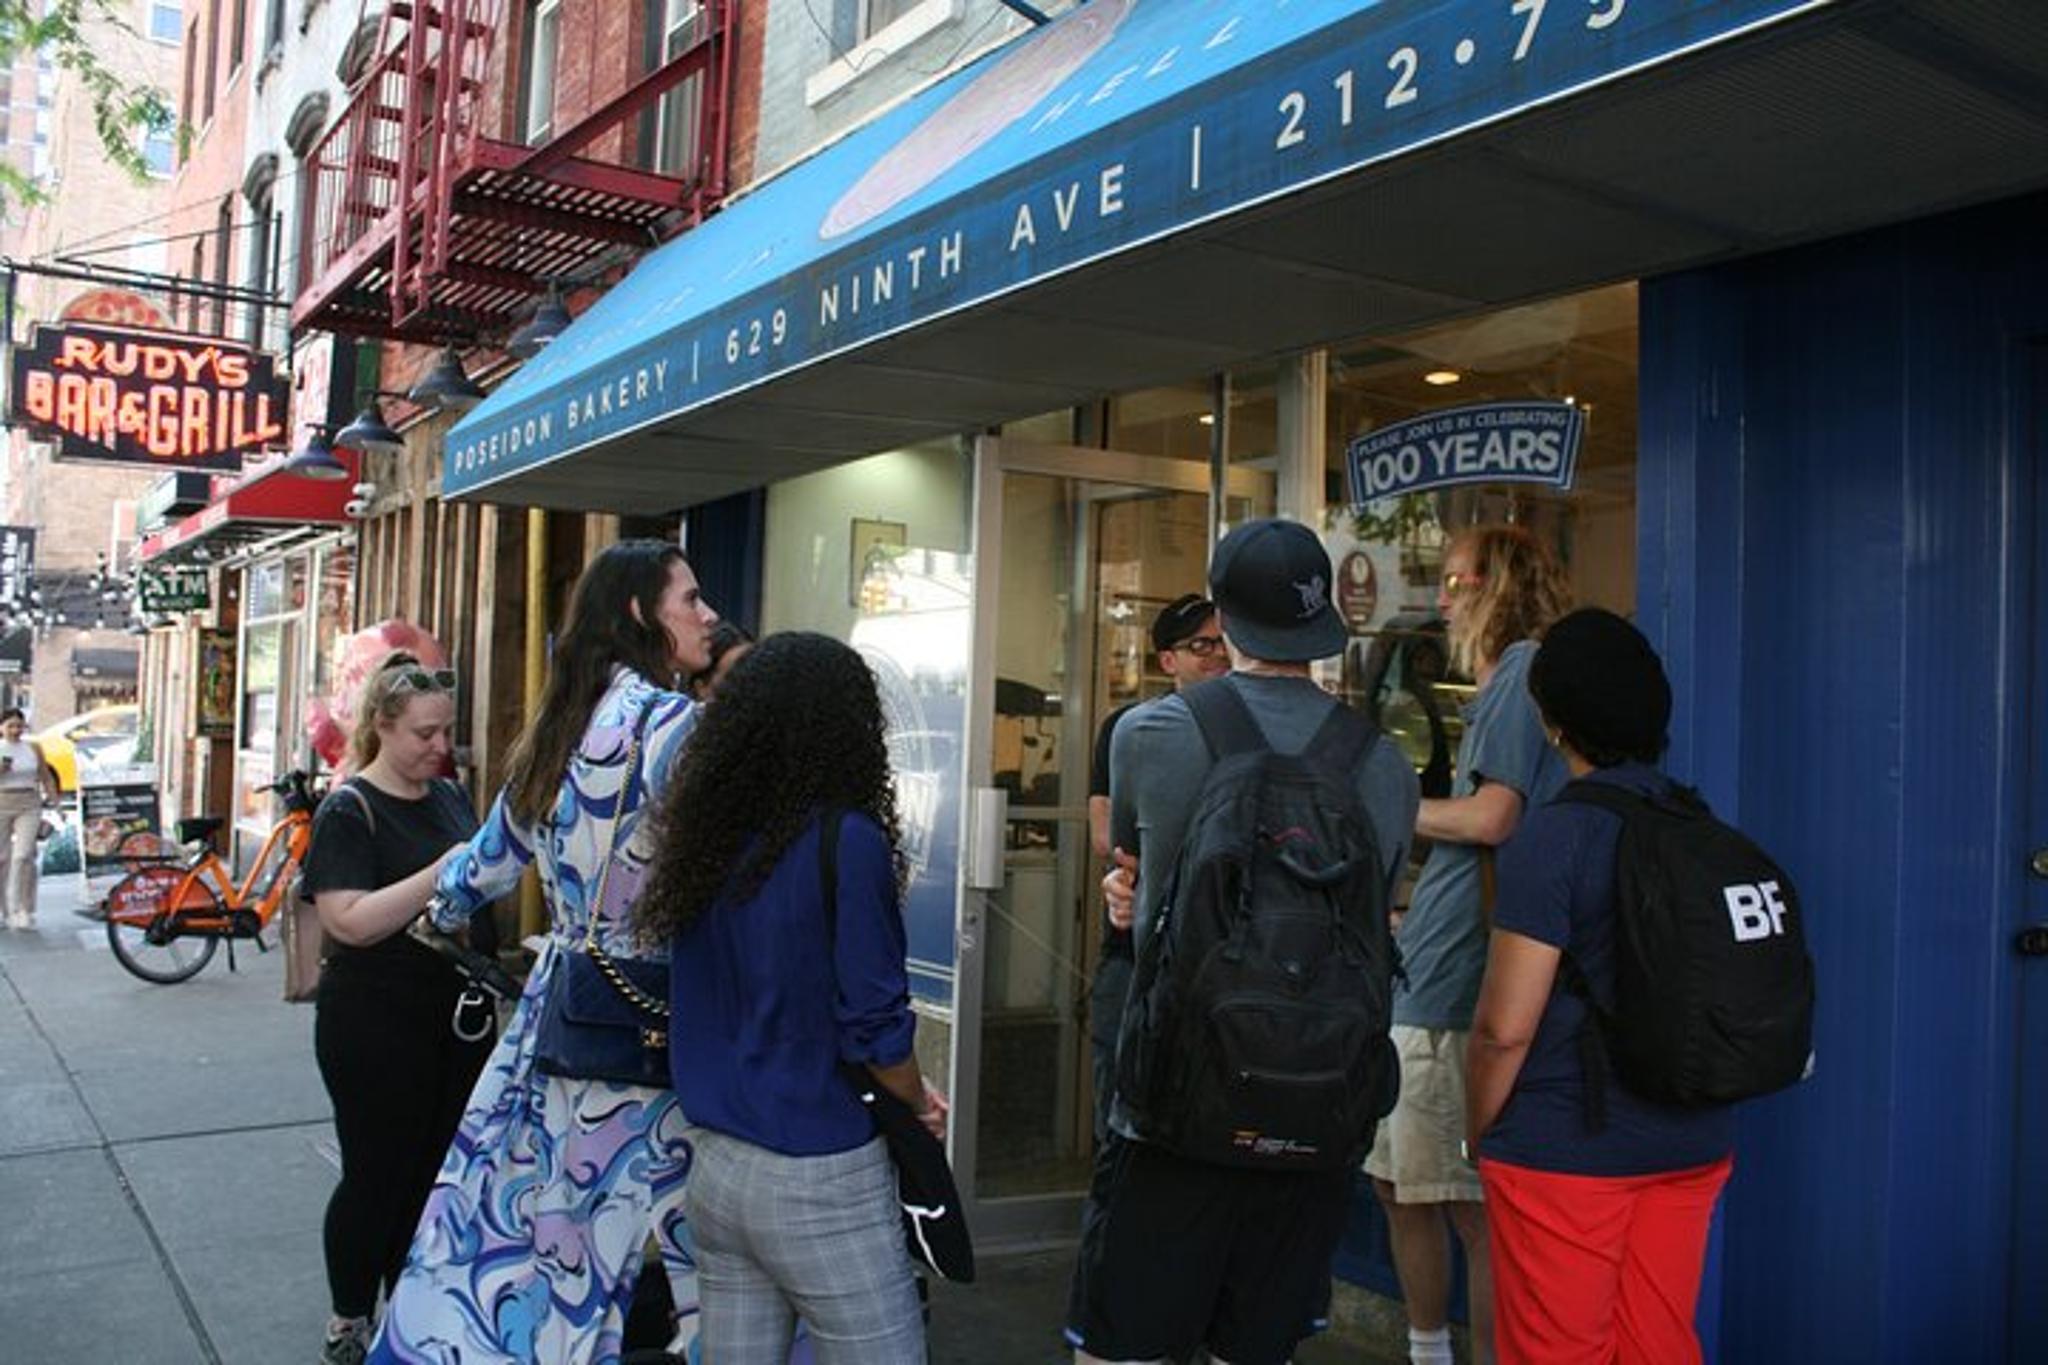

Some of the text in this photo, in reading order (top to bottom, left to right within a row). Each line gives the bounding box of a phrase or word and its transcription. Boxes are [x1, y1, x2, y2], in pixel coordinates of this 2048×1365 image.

[454, 411, 551, 476] POSEIDON
[567, 357, 670, 428] BAKERY
[725, 309, 787, 364] 629
[820, 230, 963, 326] NINTH
[1009, 164, 1125, 251] AVE
[54, 336, 250, 387] RUDY'S
[1405, 422, 1435, 441] JOIN
[1436, 419, 1454, 433] US
[1457, 416, 1472, 429] IN
[1475, 410, 1568, 428] CELEBRATING
[1359, 429, 1562, 496] 100 YEARS
[140, 570, 207, 597] ATM
[1722, 880, 1788, 942] BF
